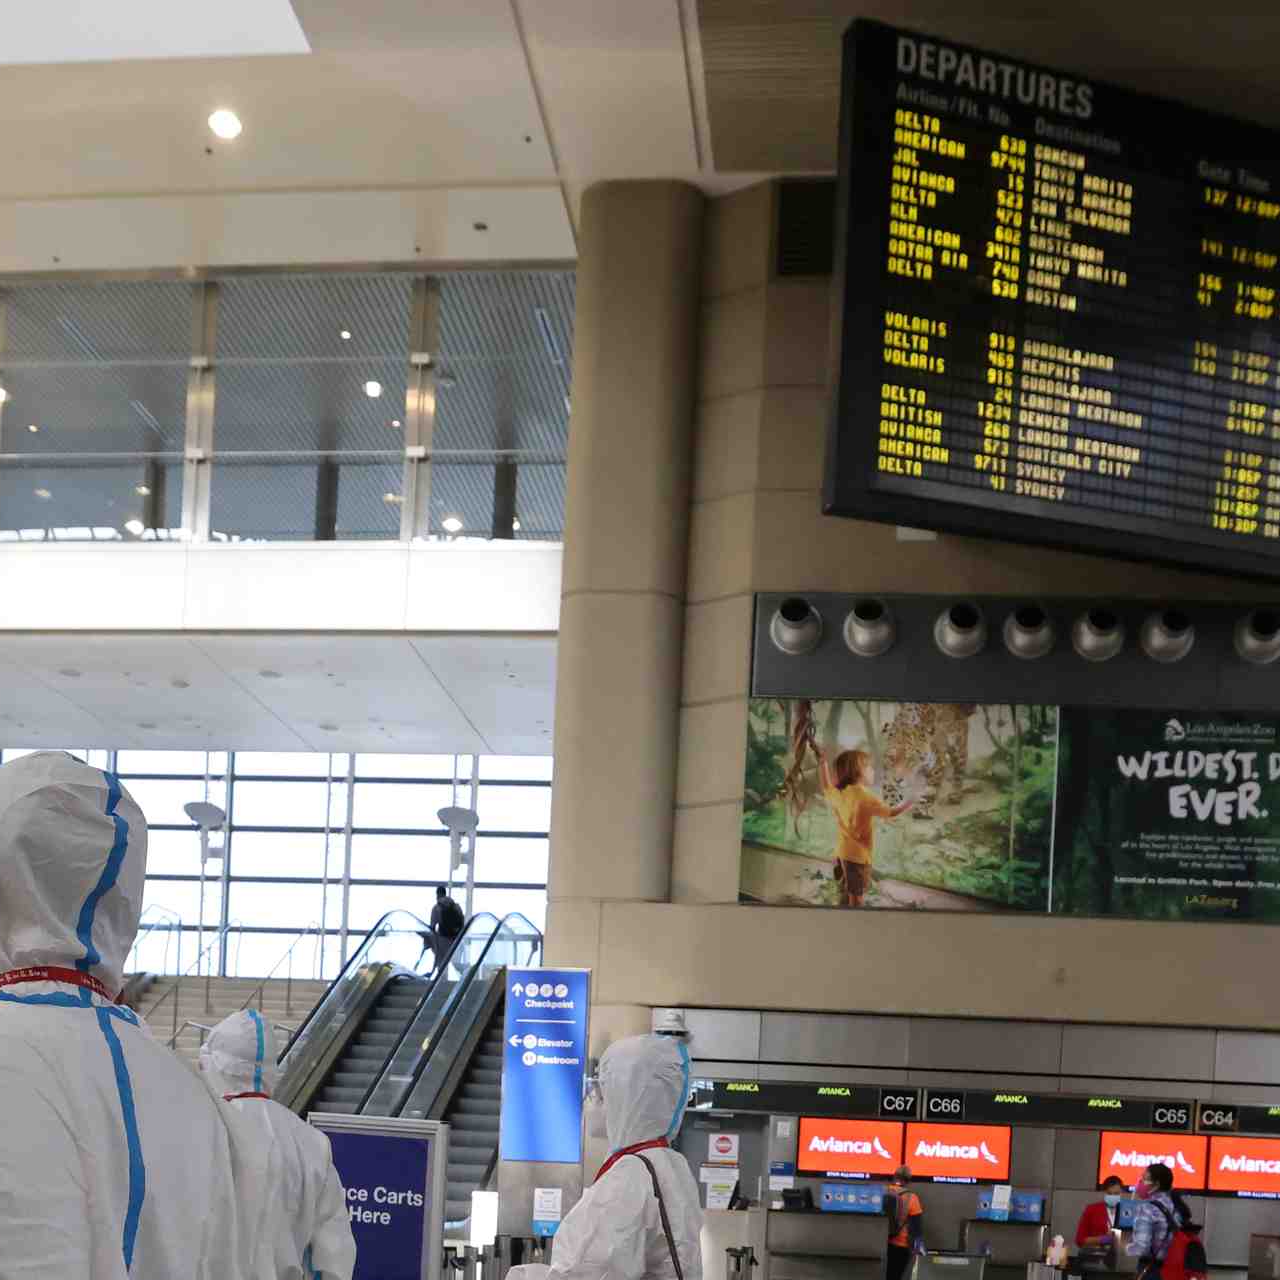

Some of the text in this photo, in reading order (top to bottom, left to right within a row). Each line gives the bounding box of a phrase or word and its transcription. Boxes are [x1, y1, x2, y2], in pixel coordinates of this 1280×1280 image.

[897, 36, 1093, 119] DEPARTURES
[895, 108, 940, 134] DELTA
[1034, 143, 1086, 170] CANCUN
[893, 147, 919, 166] JAL
[1034, 179, 1075, 204] TOKYO
[1082, 191, 1132, 217] HANEDA
[894, 127, 966, 159] AMERICAN
[1035, 161, 1075, 186] TOKYO
[1083, 173, 1133, 199] NARITA
[891, 183, 936, 208] DELTA
[1030, 215, 1071, 239] LIHUE
[892, 164, 955, 193] AVIANCA
[1032, 198, 1057, 218] SAN
[1065, 206, 1130, 235] SALVADOR
[889, 220, 960, 249] AMERICAN
[1029, 252, 1070, 275] TOKYO
[1077, 262, 1127, 288] NARITA
[890, 202, 918, 222] KLM
[1029, 233, 1105, 264] AMSTERDAM
[887, 257, 1077, 312] DELTA BOSTON
[888, 238, 933, 262] QATAR
[941, 250, 968, 269] AIR
[1027, 268, 1061, 290] DOHA
[884, 329, 929, 352] DELTA
[1022, 356, 1080, 382] MEMPHIS
[885, 311, 947, 338] VOLARIS
[1023, 338, 1114, 371] GUADALAJARA
[883, 347, 945, 374] VOLARIS
[1021, 374, 1112, 405] GUADALAJARA
[880, 401, 943, 427] BRITISH
[1018, 427, 1068, 448] LONDON
[881, 383, 926, 405] DELTA
[1020, 411, 1069, 433] DENVER
[1020, 391, 1070, 415] LONDON
[879, 438, 949, 464] AMERICAN
[1016, 461, 1065, 483] SYDNEY
[880, 419, 942, 445] AVIANCA
[1017, 444, 1091, 471] GUATEMALA
[1097, 456, 1132, 478] CITY
[878, 455, 922, 477] DELTA
[1015, 478, 1065, 500] SYDNEY
[1117, 750, 1260, 784] WILDEST.
[1168, 781, 1269, 826] EVER.
[524, 999, 575, 1010] Checkpoint
[537, 1055, 579, 1065] Restroom
[538, 1037, 574, 1048] Elevator
[726, 1083, 759, 1093] AVIANCA
[818, 1087, 851, 1097] AVIANCA
[883, 1096, 914, 1112] C67
[930, 1098, 961, 1113] C66
[994, 1094, 1028, 1105] AVIANCA
[1088, 1098, 1122, 1109] AVIANCA
[1155, 1108, 1187, 1124] C65
[1202, 1110, 1234, 1126] C64
[809, 1136, 872, 1155] Avianca
[915, 1140, 979, 1160] Avianca
[349, 1206, 391, 1225] Here
[373, 1186, 424, 1206] Carts
